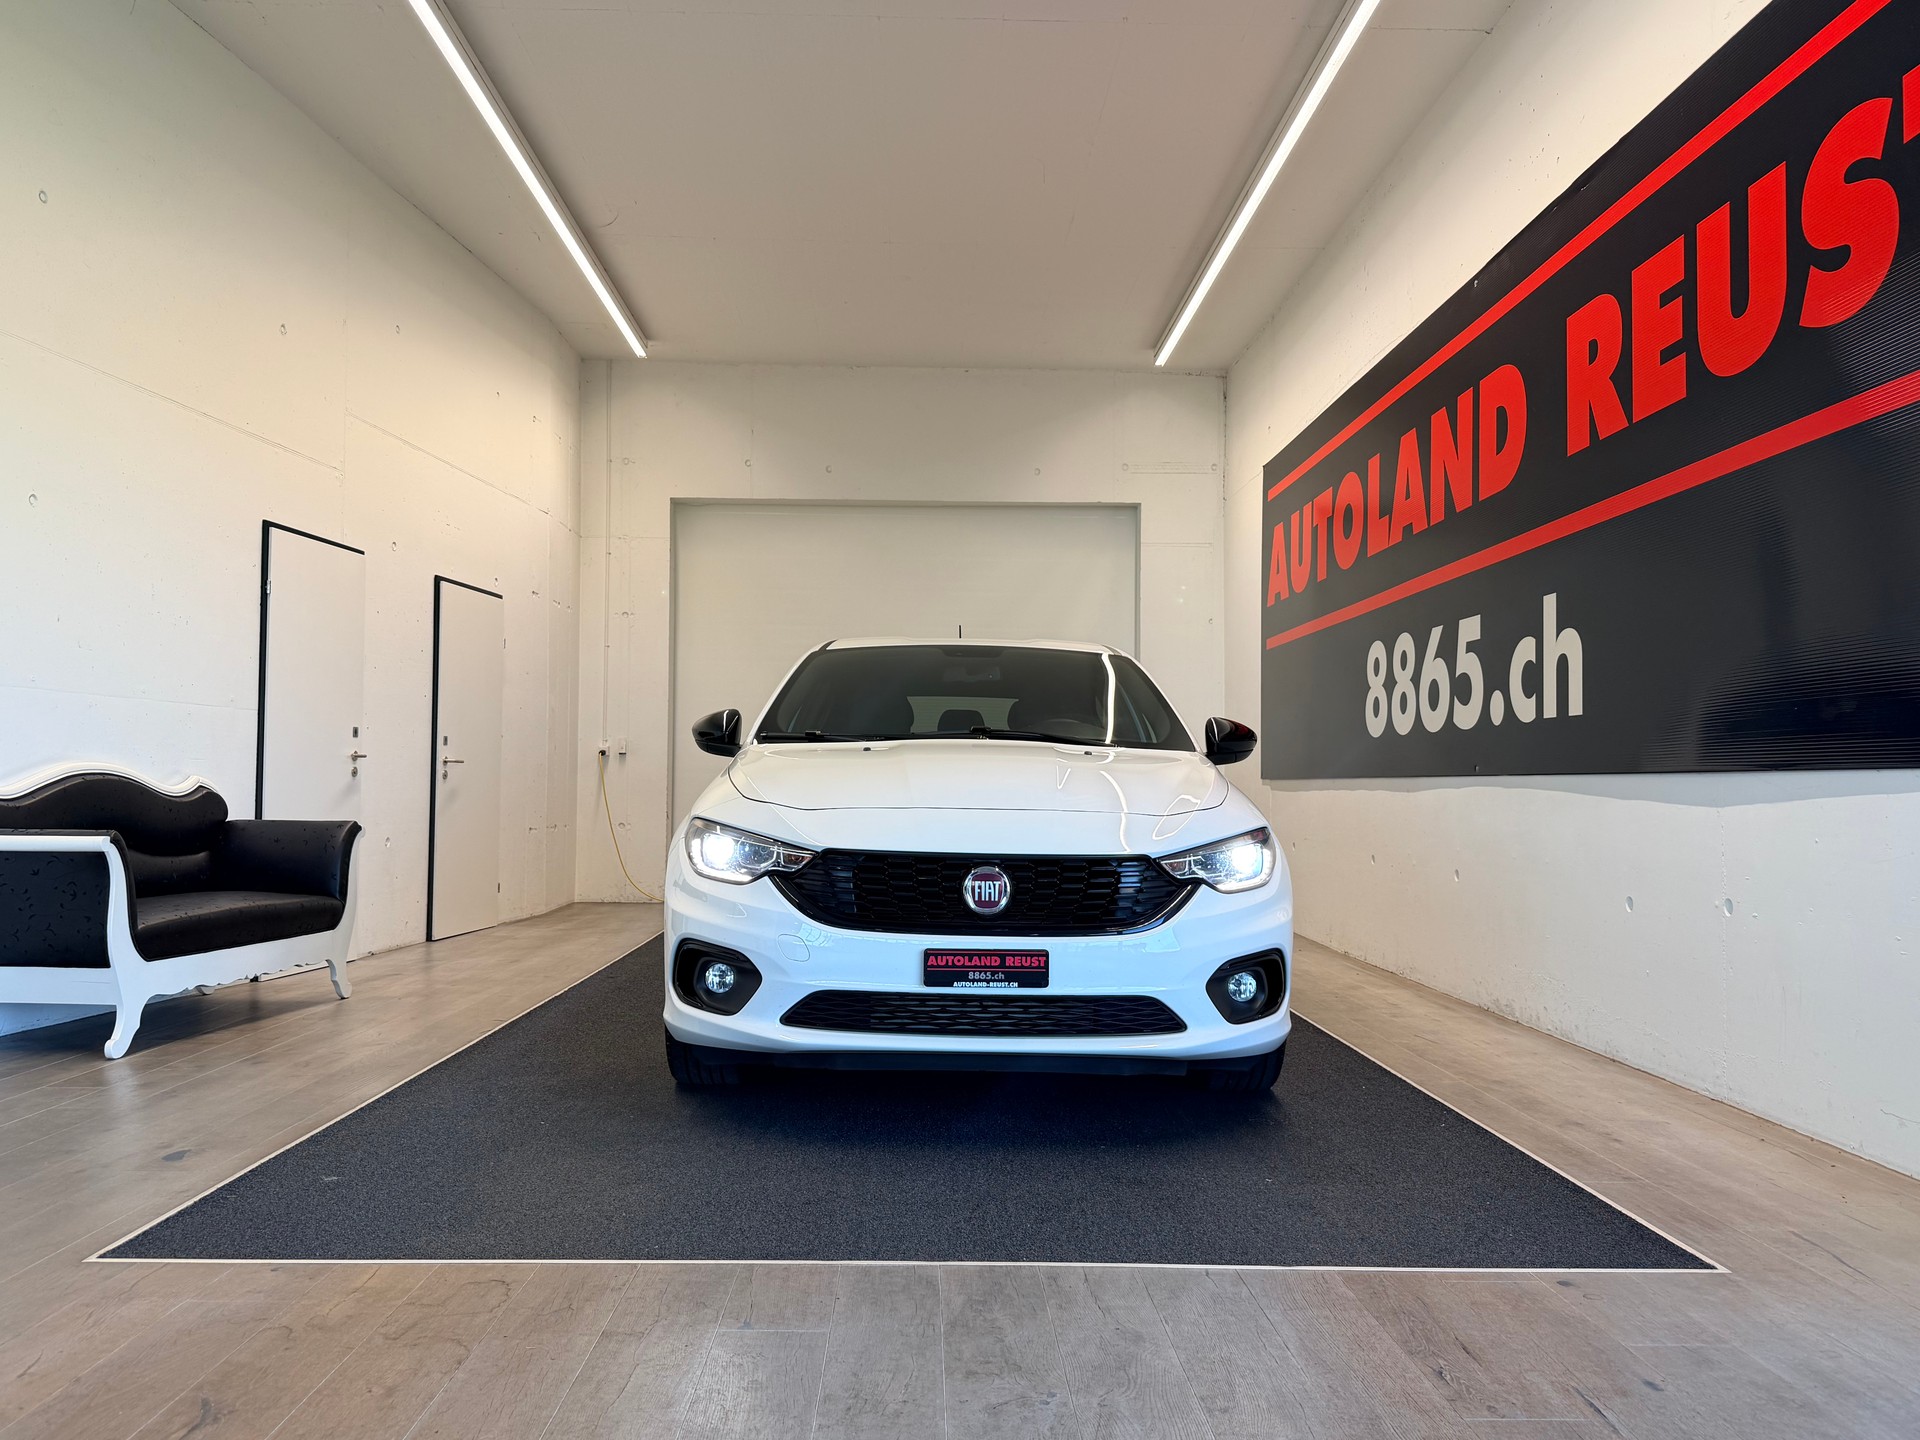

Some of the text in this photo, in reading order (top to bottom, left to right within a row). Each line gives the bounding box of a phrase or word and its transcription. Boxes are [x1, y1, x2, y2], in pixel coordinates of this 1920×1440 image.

[1267, 65, 1920, 606] AUTOLAND REUS
[1365, 592, 1583, 739] 8865.ch
[974, 880, 1001, 902] FIAT
[927, 955, 1047, 967] AUTOLAND REUST
[968, 971, 1005, 980] 8865.ch
